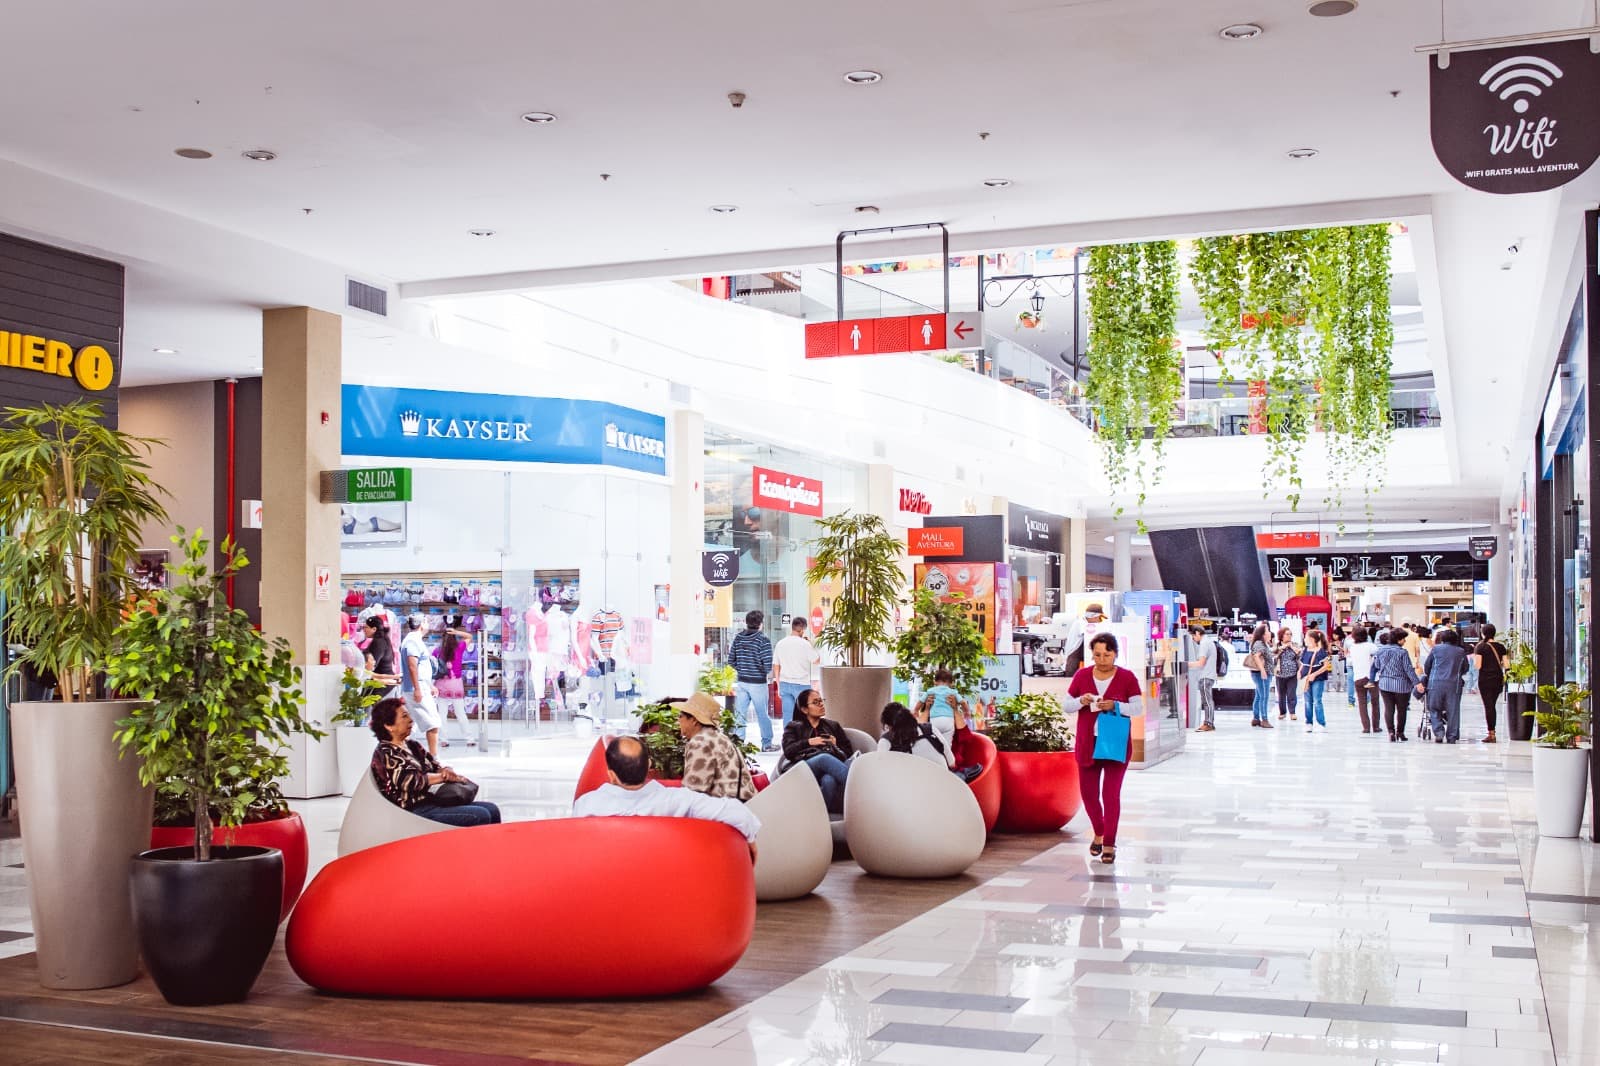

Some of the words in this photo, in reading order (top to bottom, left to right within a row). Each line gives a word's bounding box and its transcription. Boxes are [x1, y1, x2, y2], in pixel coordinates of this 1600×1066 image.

[1483, 116, 1558, 159] Wifi
[1485, 167, 1513, 176] GRATIS
[1514, 166, 1535, 174] MALL
[1537, 163, 1580, 173] AVENTURA
[425, 418, 533, 442] KAYSER
[617, 431, 665, 458] KAYSER
[356, 470, 396, 488] SALIDA
[916, 541, 955, 549] AVENTURA
[921, 533, 945, 541] MALL
